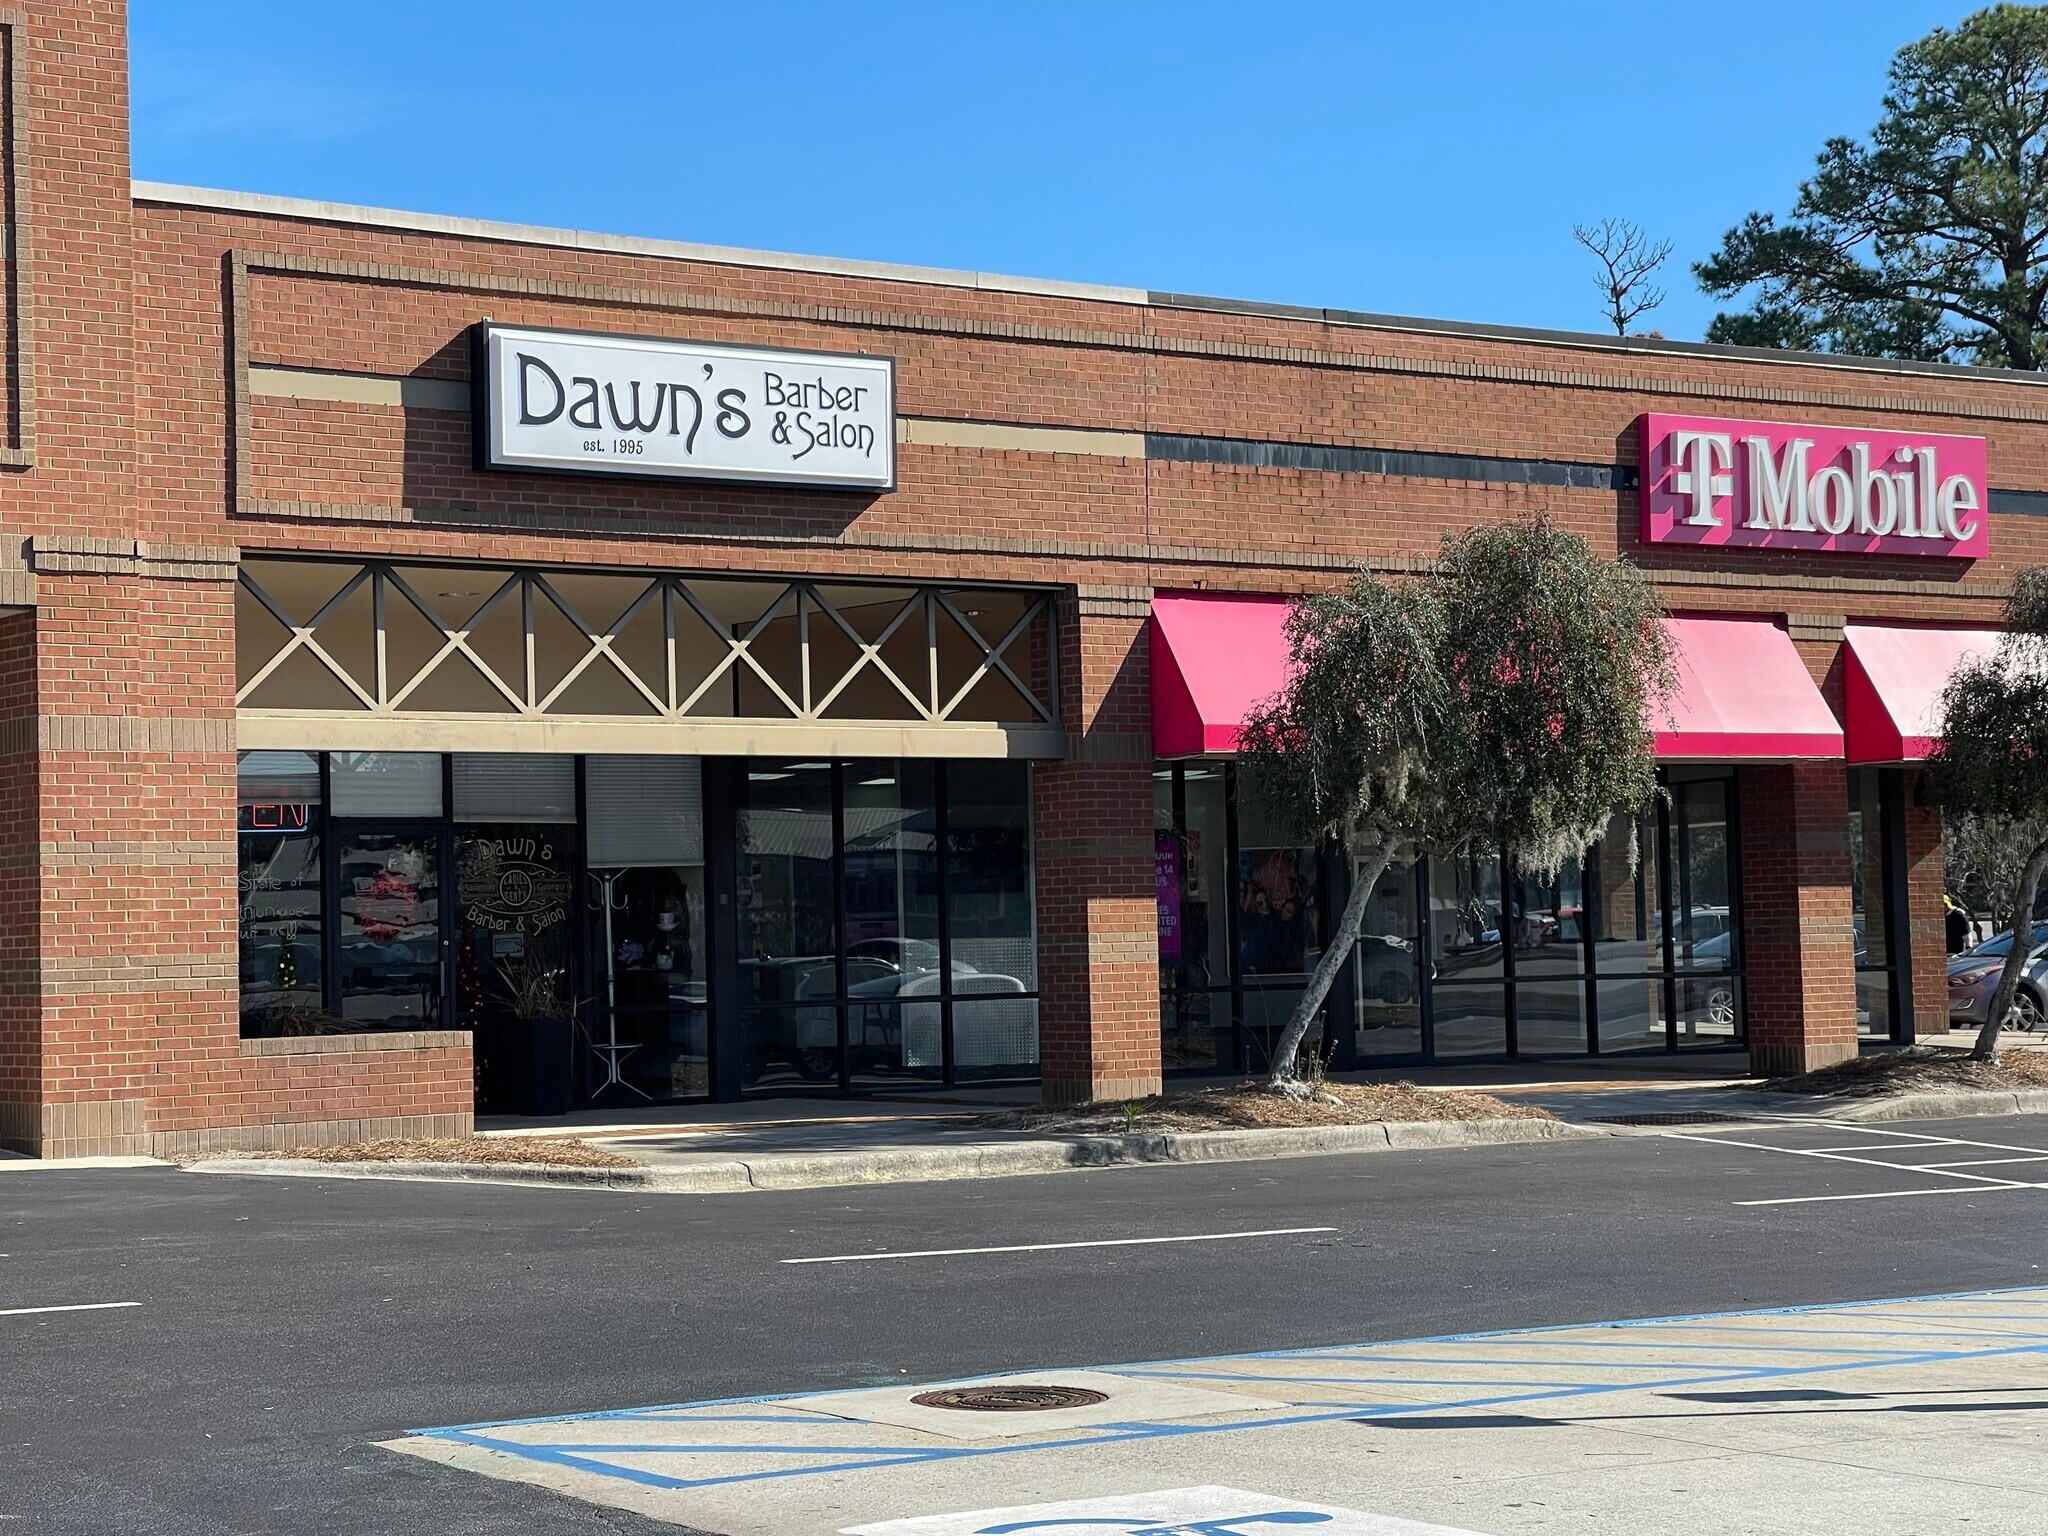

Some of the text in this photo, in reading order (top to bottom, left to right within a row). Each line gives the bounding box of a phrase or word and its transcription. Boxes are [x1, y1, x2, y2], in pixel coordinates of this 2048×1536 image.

[516, 351, 752, 455] Dawn's
[763, 371, 869, 413] Barber
[583, 438, 644, 455] est. 1995
[1741, 435, 1980, 542] Mobile
[477, 834, 553, 862] Dawn's
[290, 871, 304, 887] of
[466, 905, 567, 937] Barber & Salon
